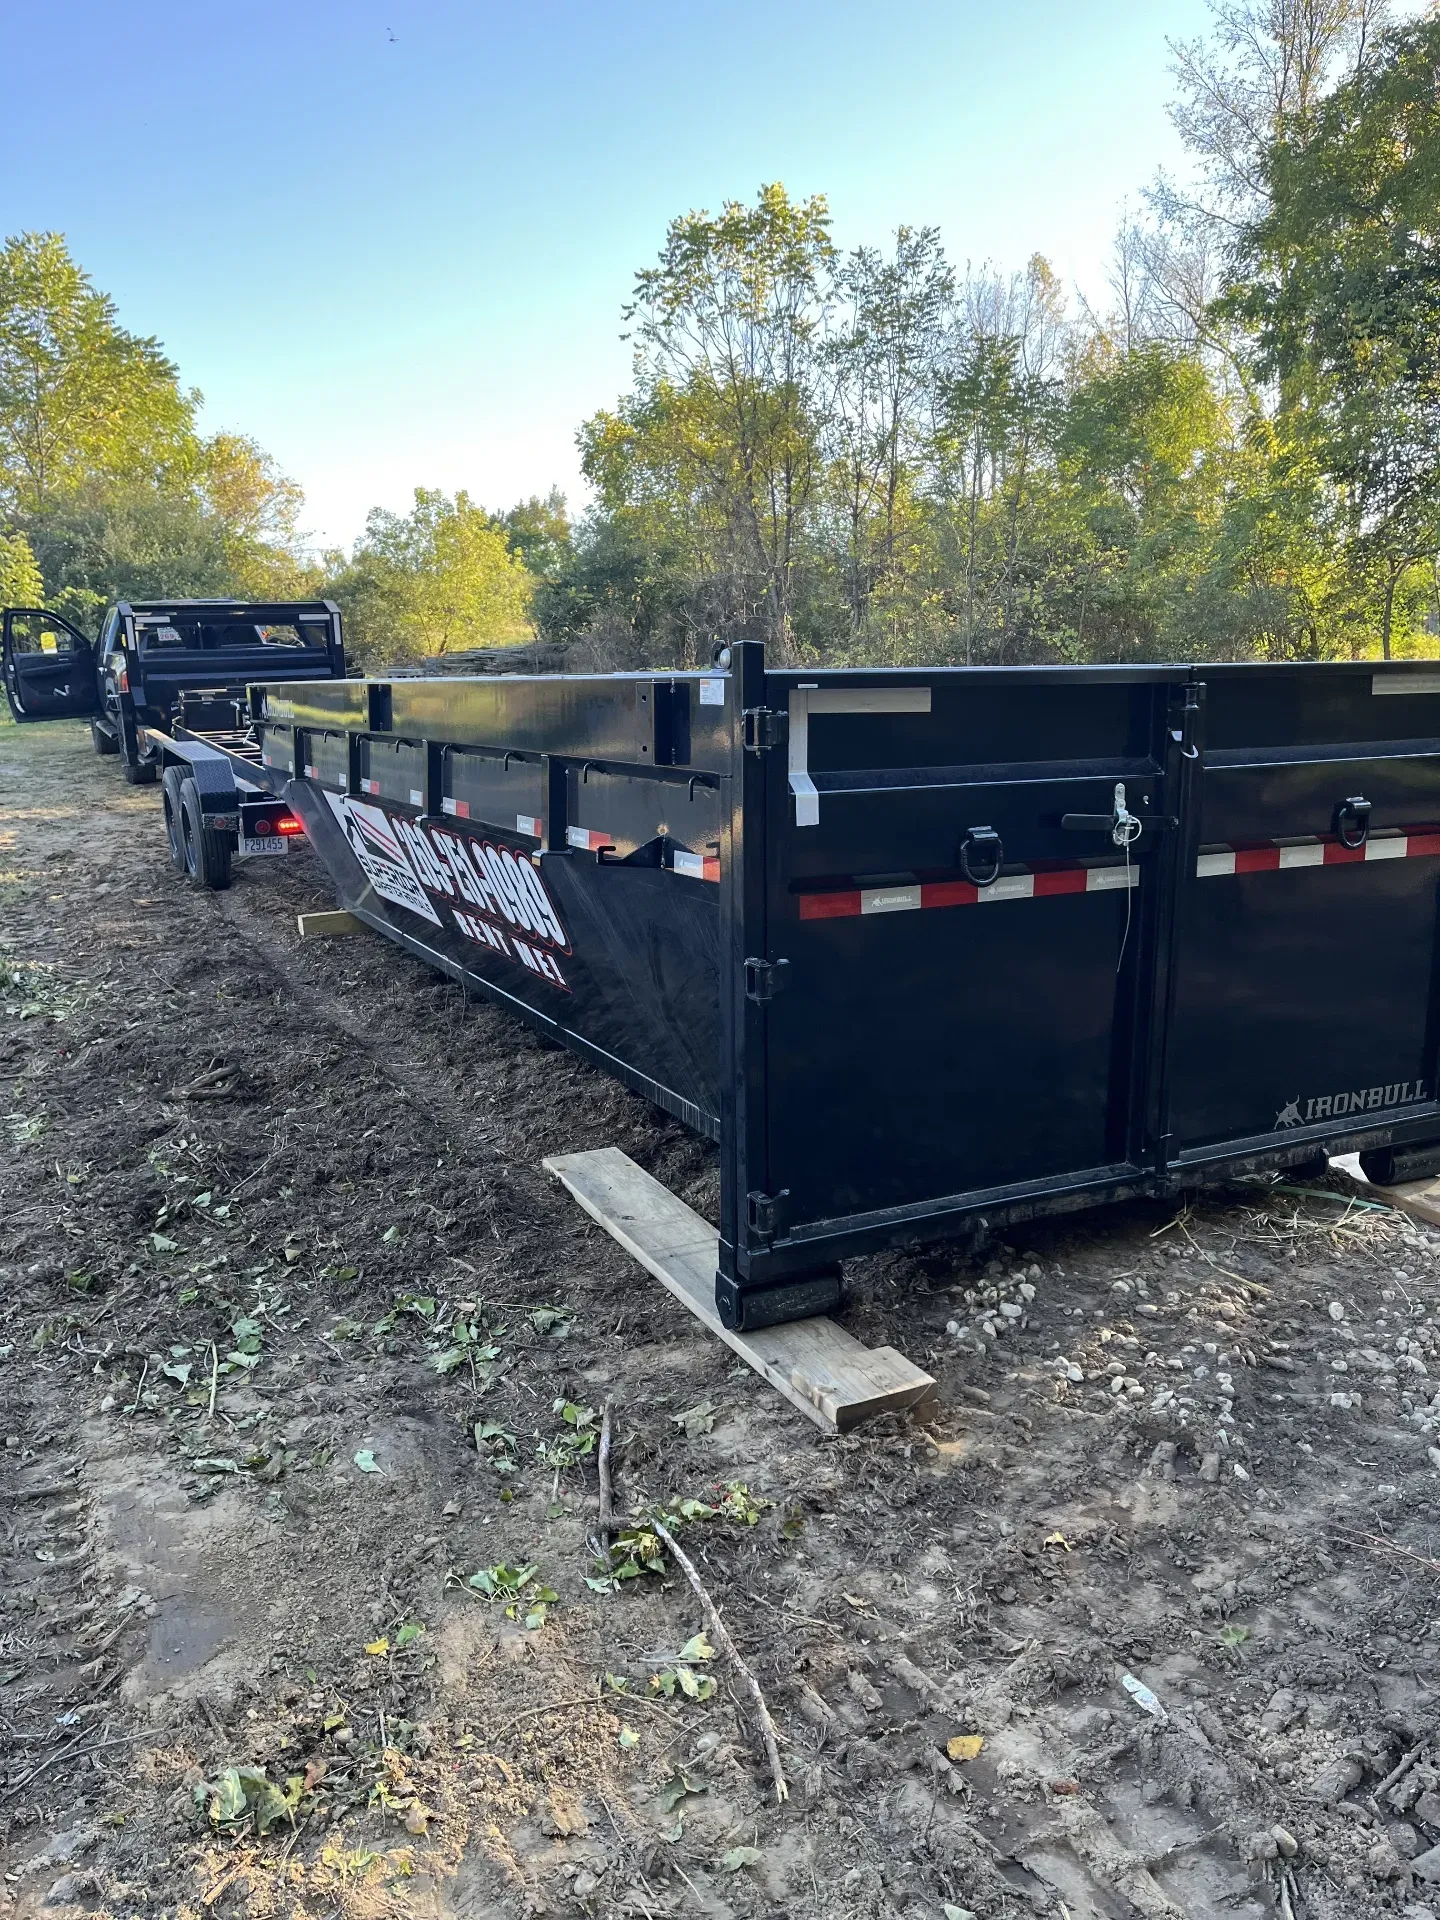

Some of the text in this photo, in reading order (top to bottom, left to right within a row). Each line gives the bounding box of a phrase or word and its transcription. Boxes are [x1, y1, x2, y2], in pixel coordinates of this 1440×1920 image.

[244, 837, 283, 852] F291455
[357, 852, 426, 901] SUPERIOR
[390, 816, 567, 947] 269-251-0989
[451, 909, 512, 957] RENT
[1306, 1079, 1428, 1120] IRONBULL
